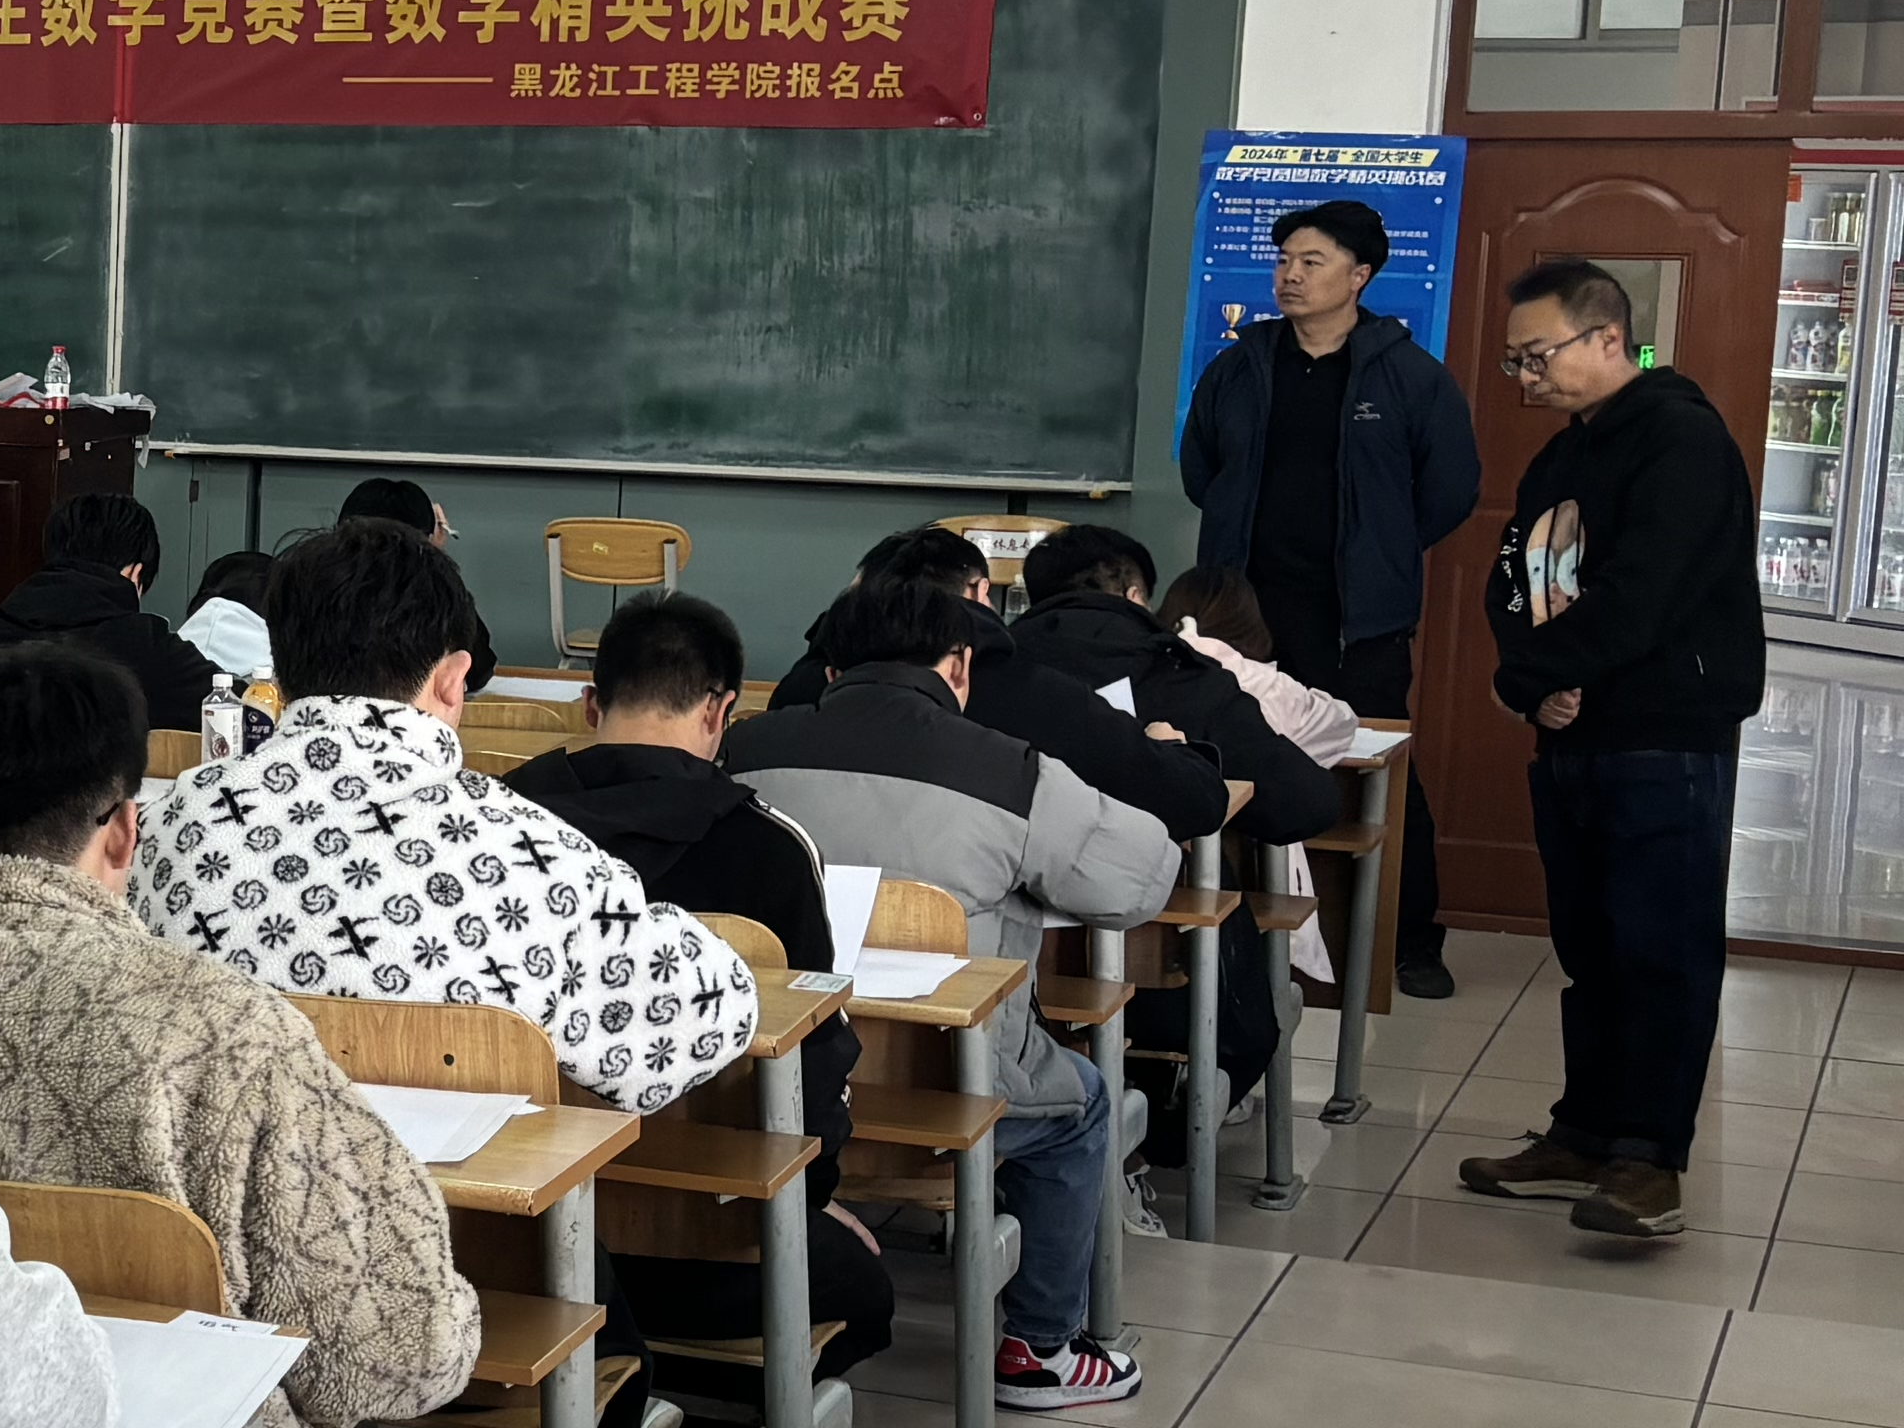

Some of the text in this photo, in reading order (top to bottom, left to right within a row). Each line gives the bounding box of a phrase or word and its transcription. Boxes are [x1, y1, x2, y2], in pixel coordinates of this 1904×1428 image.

[510, 60, 905, 101] 黑龙江工程学院报名点
